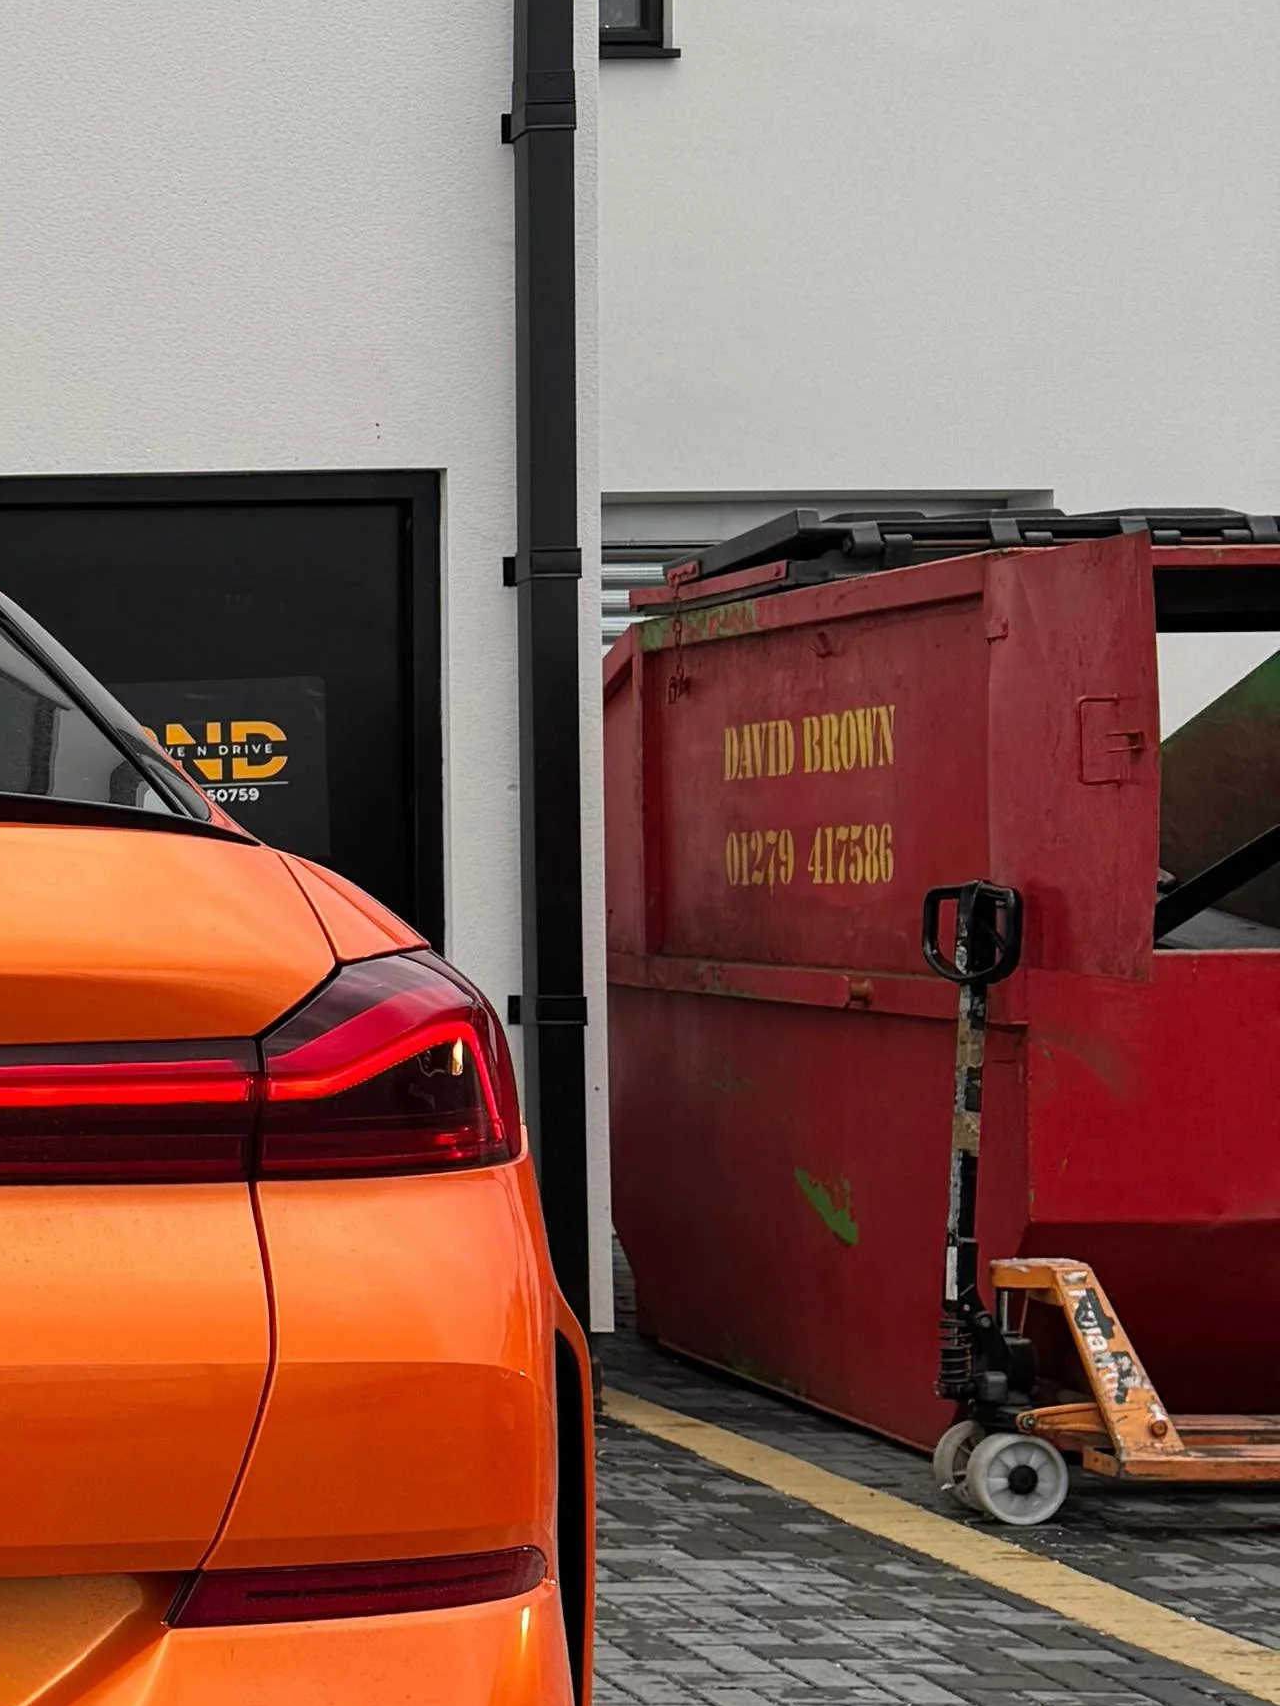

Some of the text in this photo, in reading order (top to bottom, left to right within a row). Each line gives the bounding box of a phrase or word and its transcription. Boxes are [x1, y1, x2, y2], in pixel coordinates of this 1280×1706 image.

[143, 720, 289, 781] ND
[197, 745, 207, 757] N
[218, 742, 274, 756] DRIVE
[723, 704, 896, 781] DAVID BROWN
[206, 786, 261, 803] 50759
[725, 822, 895, 887] 01279 417586
